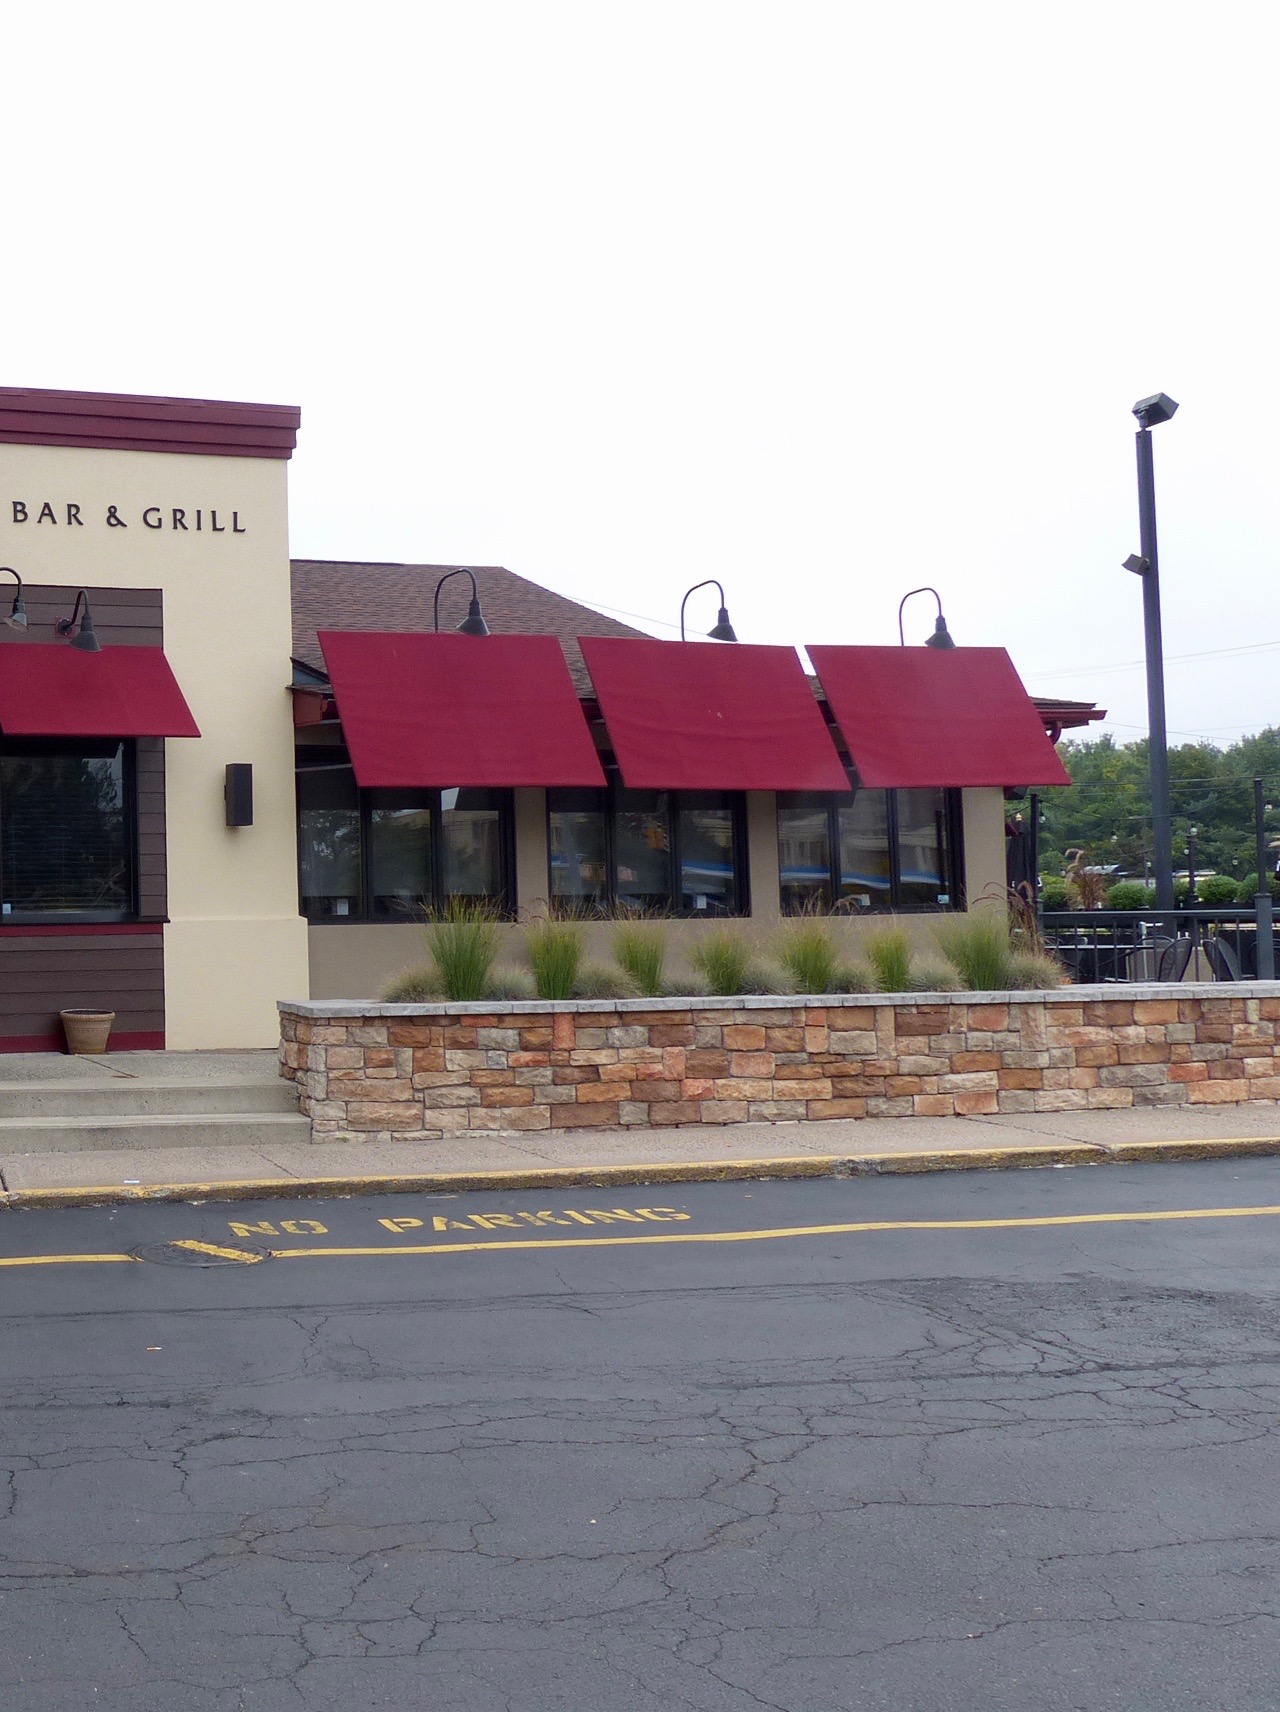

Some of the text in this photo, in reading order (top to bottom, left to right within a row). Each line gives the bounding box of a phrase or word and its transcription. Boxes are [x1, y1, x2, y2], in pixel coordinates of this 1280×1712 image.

[11, 500, 247, 533] BAR & GRILL
[227, 1206, 692, 1237] NO PARKING
